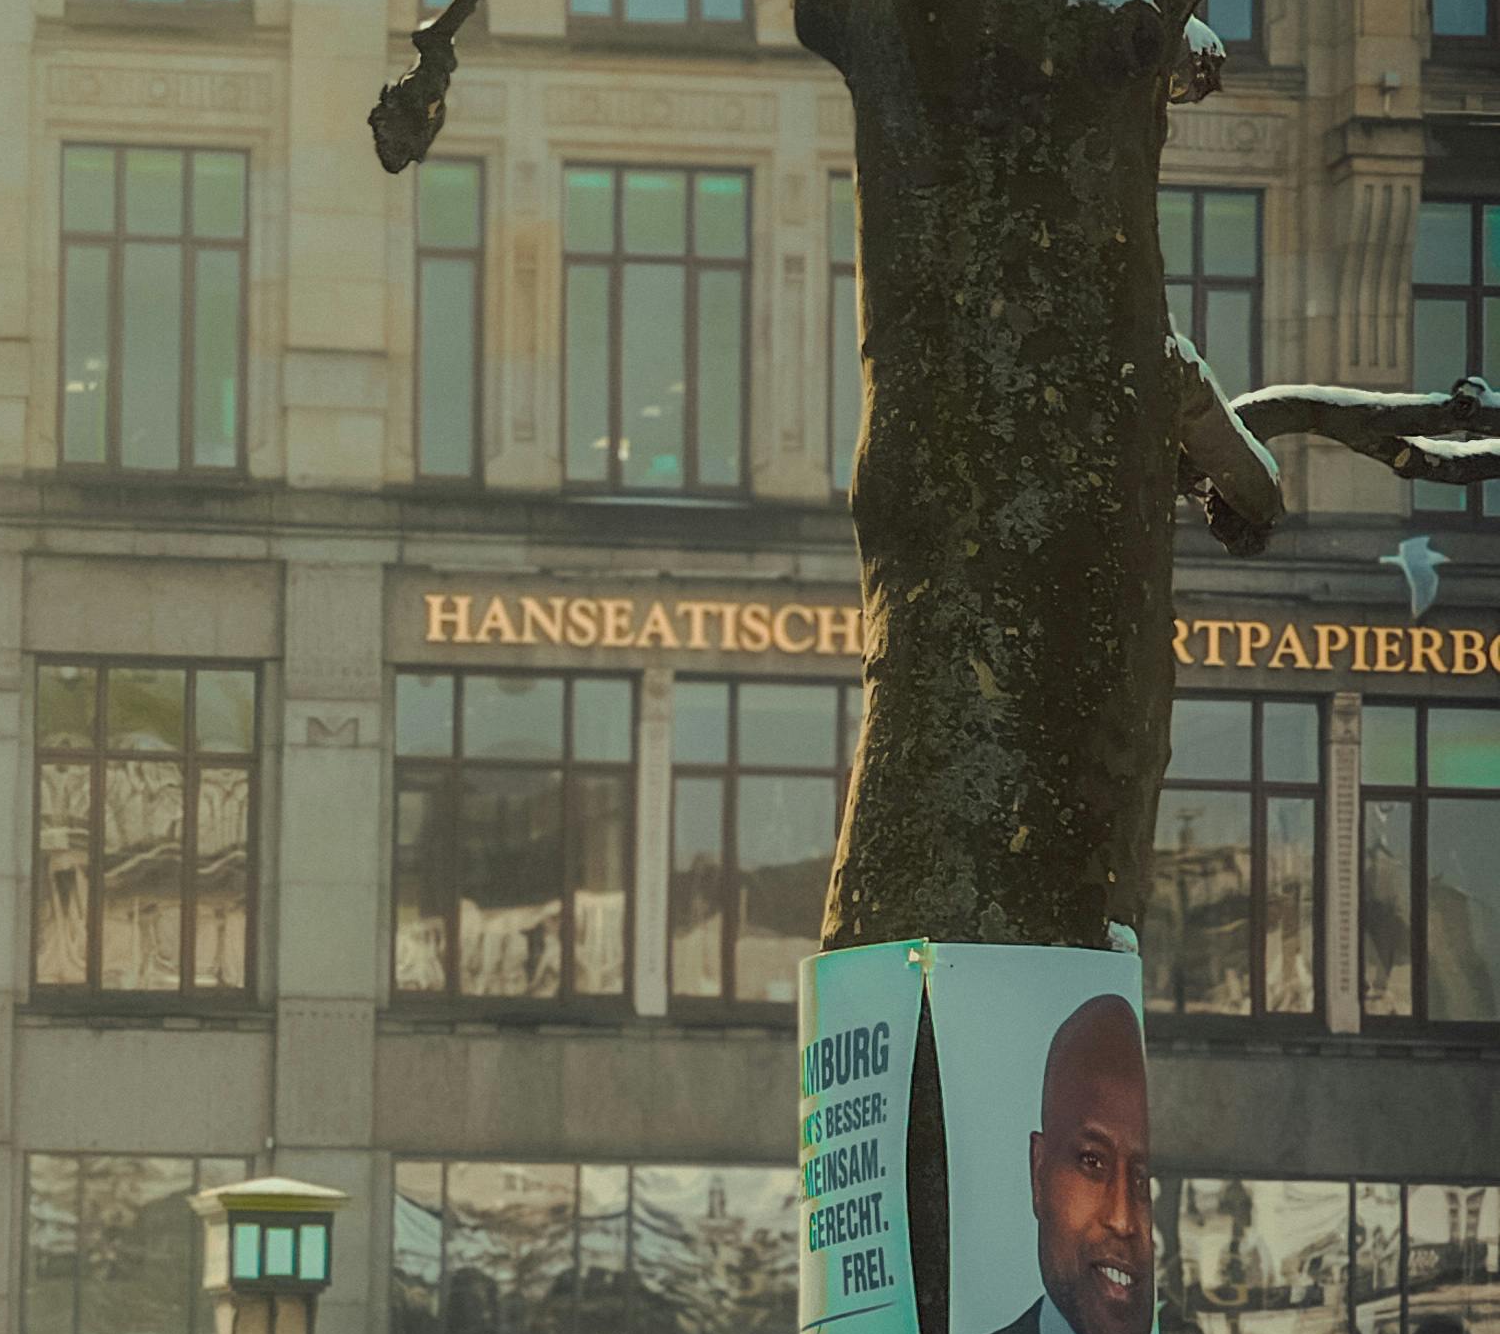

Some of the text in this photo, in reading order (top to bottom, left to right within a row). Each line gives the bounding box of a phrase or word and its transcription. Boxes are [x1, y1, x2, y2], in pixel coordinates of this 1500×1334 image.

[425, 594, 1500, 674] HANSEATISCH RTPAPIERB
[802, 1021, 889, 1099] MBURG
[825, 1092, 888, 1139] BESSER:
[802, 1138, 886, 1201] MEINSAM.
[809, 1191, 889, 1252] GERECHT.
[842, 1246, 894, 1296] FREI.
